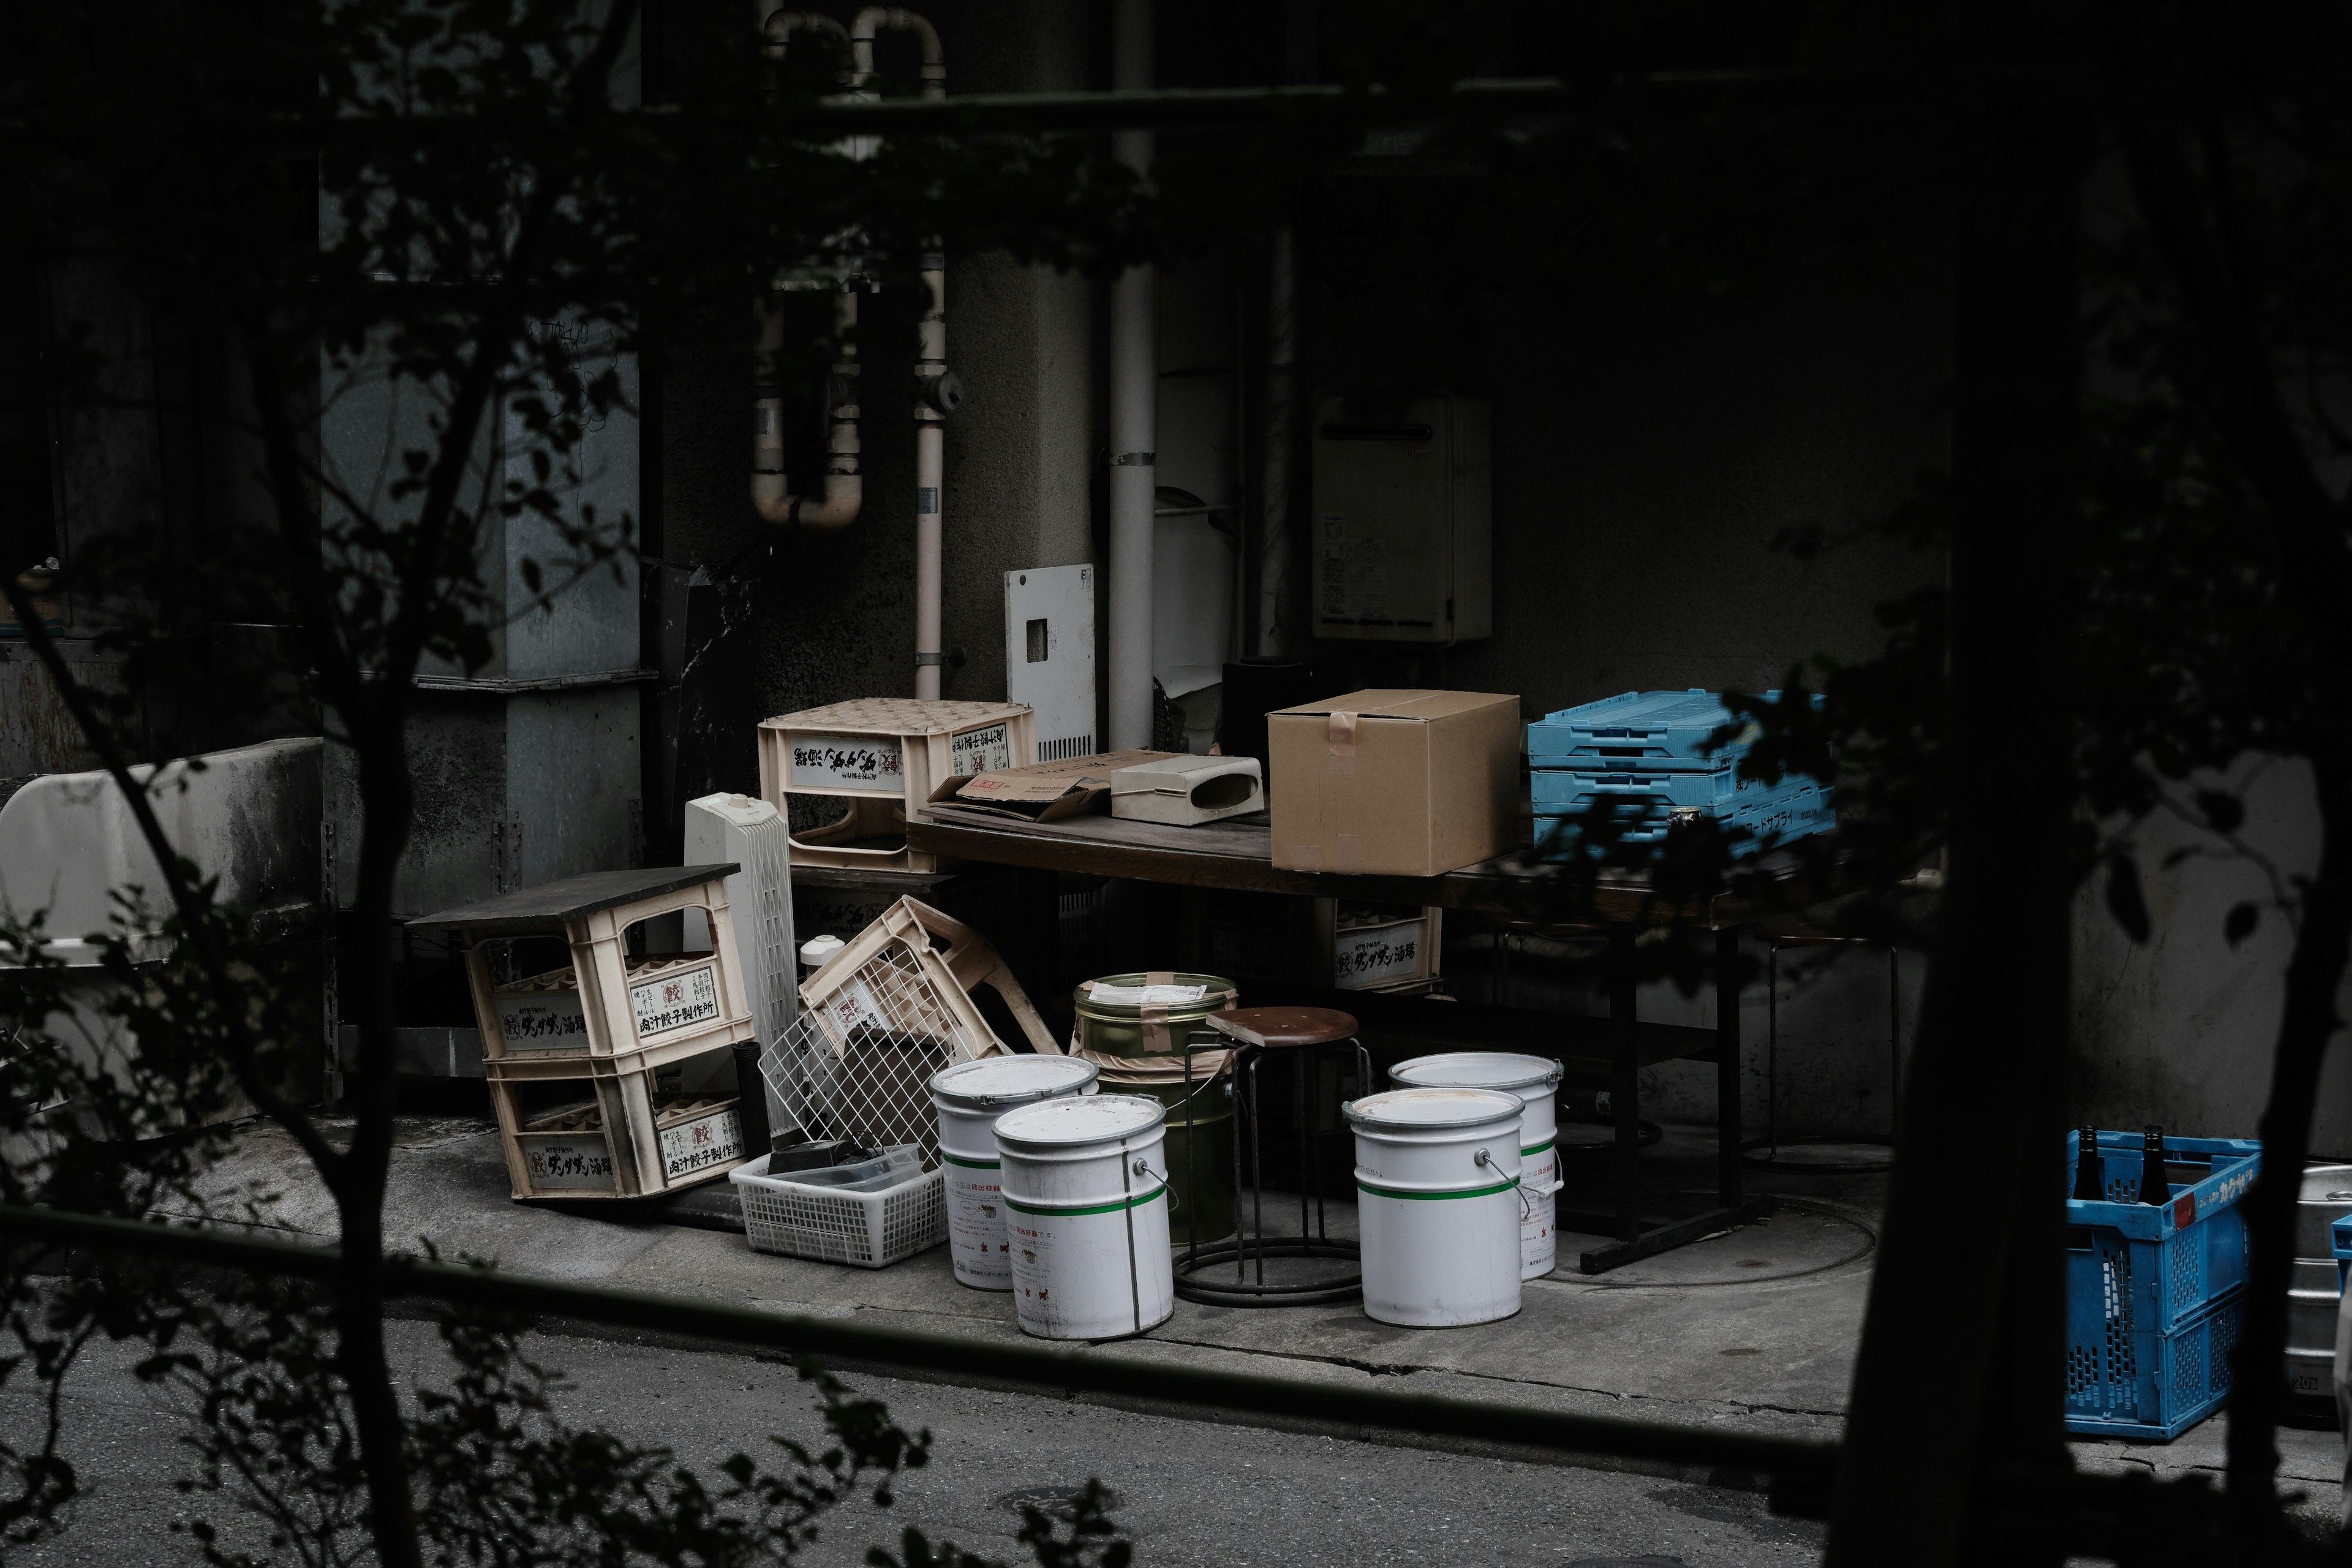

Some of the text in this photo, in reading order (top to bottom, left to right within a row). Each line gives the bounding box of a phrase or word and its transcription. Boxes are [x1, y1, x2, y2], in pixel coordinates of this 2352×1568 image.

[881, 754, 899, 773] 餃
[973, 754, 984, 772] 餃
[1739, 809, 1793, 834] フードサプライ
[1800, 808, 1819, 821] 2022.06
[665, 984, 682, 1003] 餃
[697, 973, 706, 1000] 手羽餃子
[646, 988, 655, 1014] 生ビール
[639, 1001, 714, 1033] 肉汁餃子製作所
[676, 1130, 684, 1155] 生ビール
[694, 1125, 710, 1145] 餃
[531, 1155, 546, 1174] 餃
[669, 1140, 742, 1175] 肉汁餃子製作所
